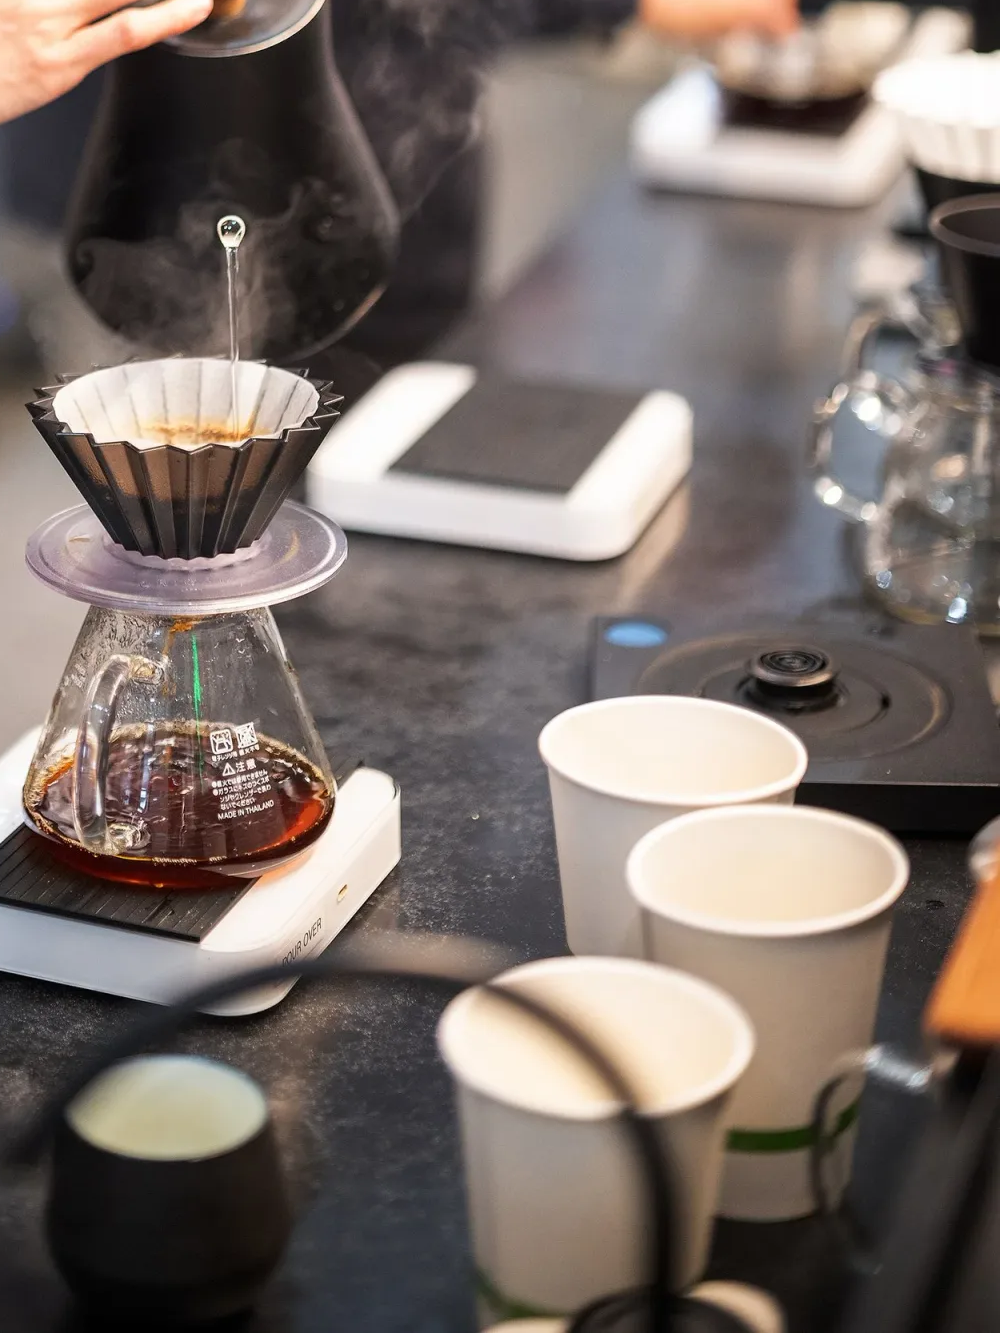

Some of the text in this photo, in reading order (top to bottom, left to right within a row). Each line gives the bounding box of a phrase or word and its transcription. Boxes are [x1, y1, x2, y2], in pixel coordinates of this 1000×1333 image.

[236, 758, 256, 773] 注意
[217, 799, 275, 821] MADE IN THAILAND
[282, 917, 322, 967] POUR OVER
